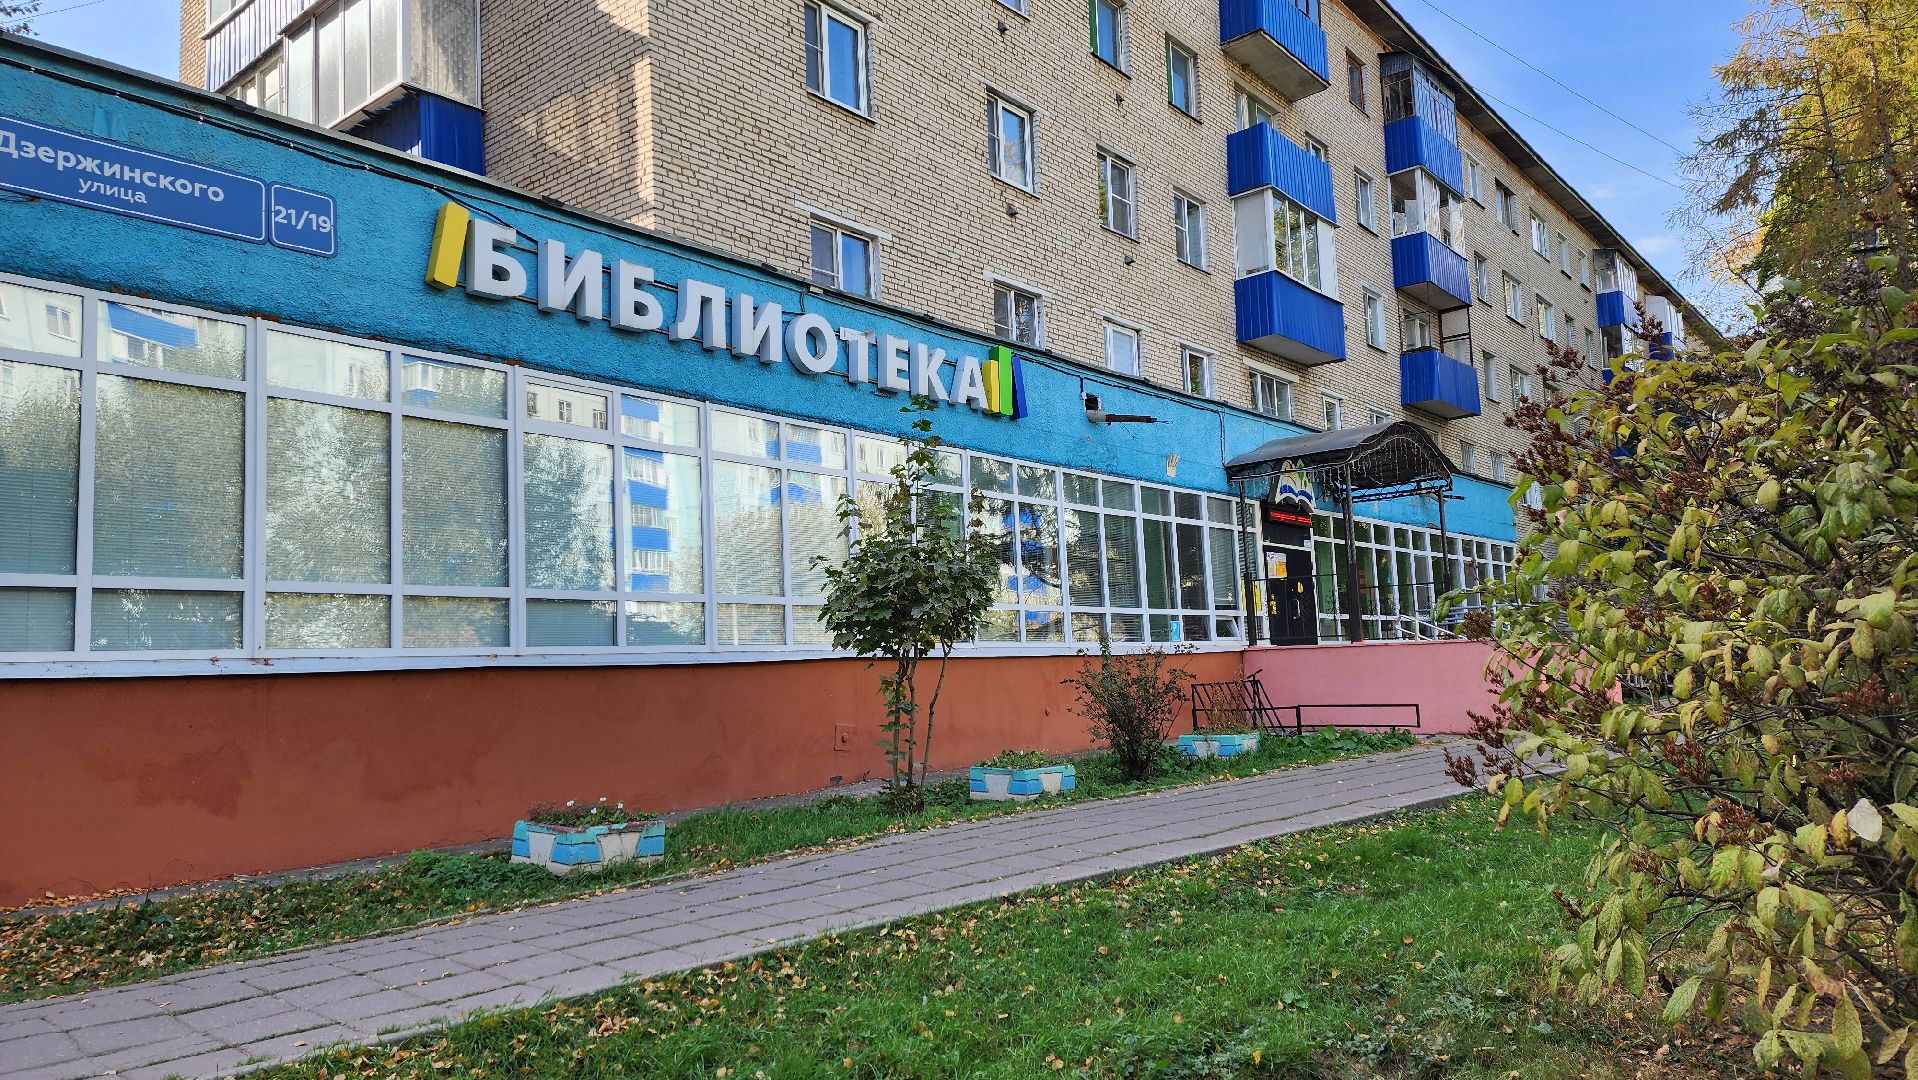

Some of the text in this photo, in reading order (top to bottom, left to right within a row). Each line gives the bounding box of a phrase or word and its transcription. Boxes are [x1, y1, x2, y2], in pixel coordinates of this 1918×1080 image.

[0, 130, 225, 203] Дзержинского
[78, 176, 148, 205] улица
[274, 205, 331, 233] 21/19
[465, 217, 988, 411] БИБЛИОТЕКА
